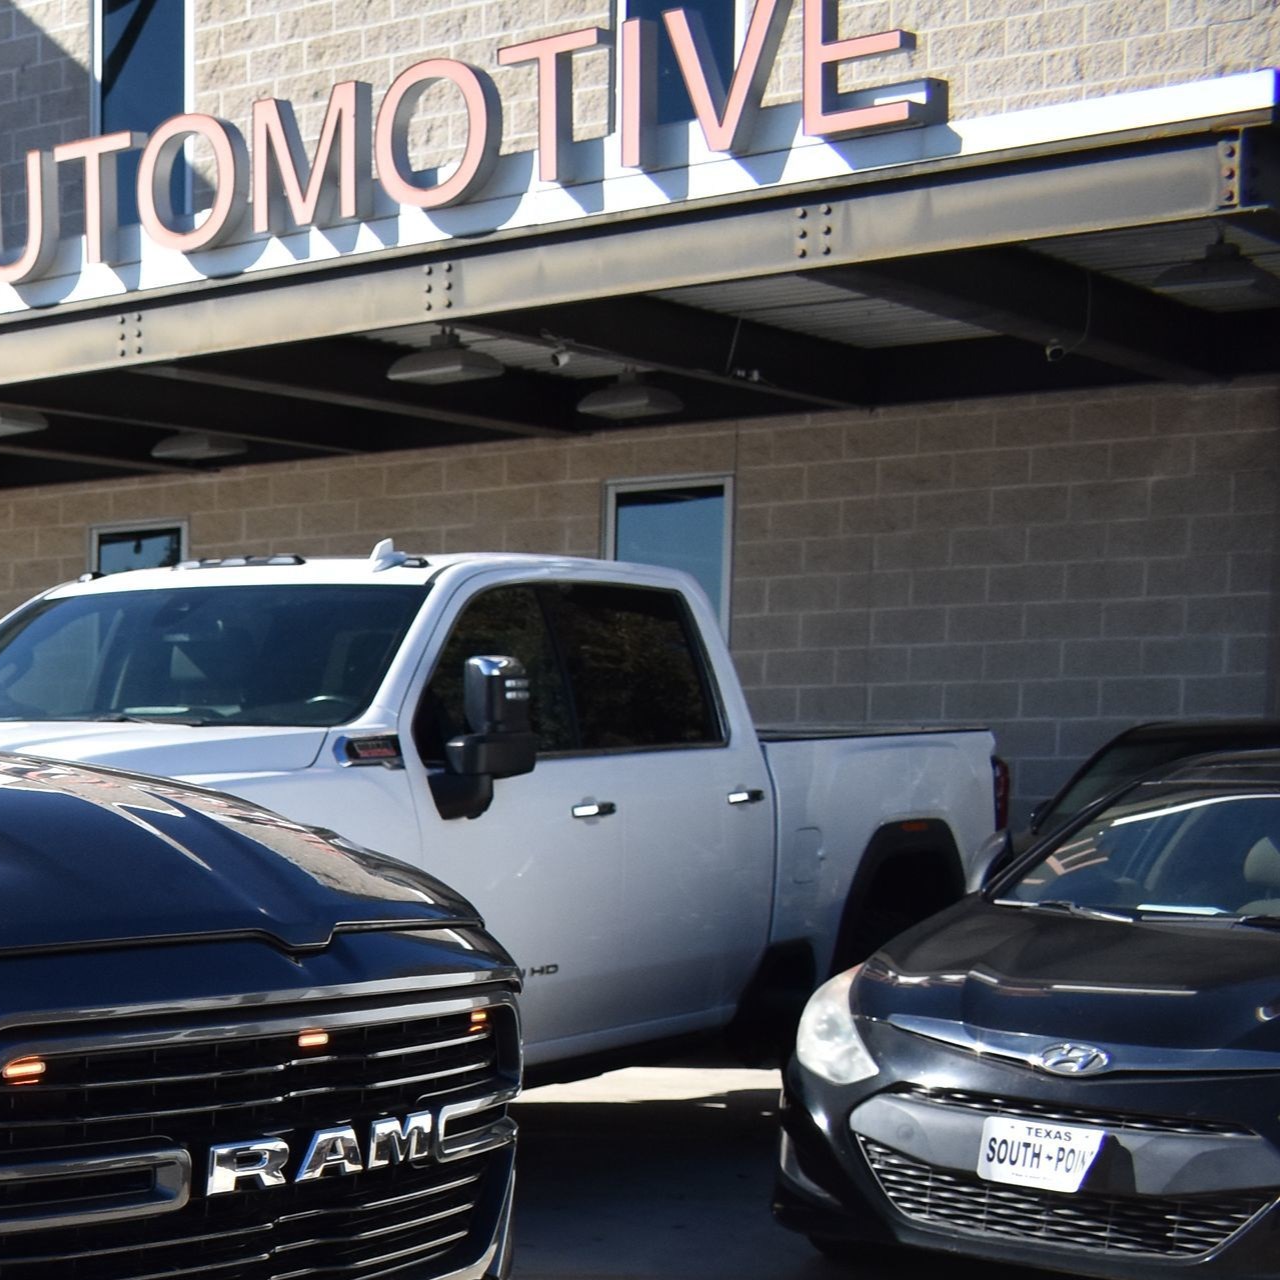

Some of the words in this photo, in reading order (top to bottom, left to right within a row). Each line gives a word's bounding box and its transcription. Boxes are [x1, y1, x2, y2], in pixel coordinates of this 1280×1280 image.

[529, 964, 559, 977] HD
[1025, 1126, 1072, 1142] TEXAS
[206, 1110, 432, 1196] RAM
